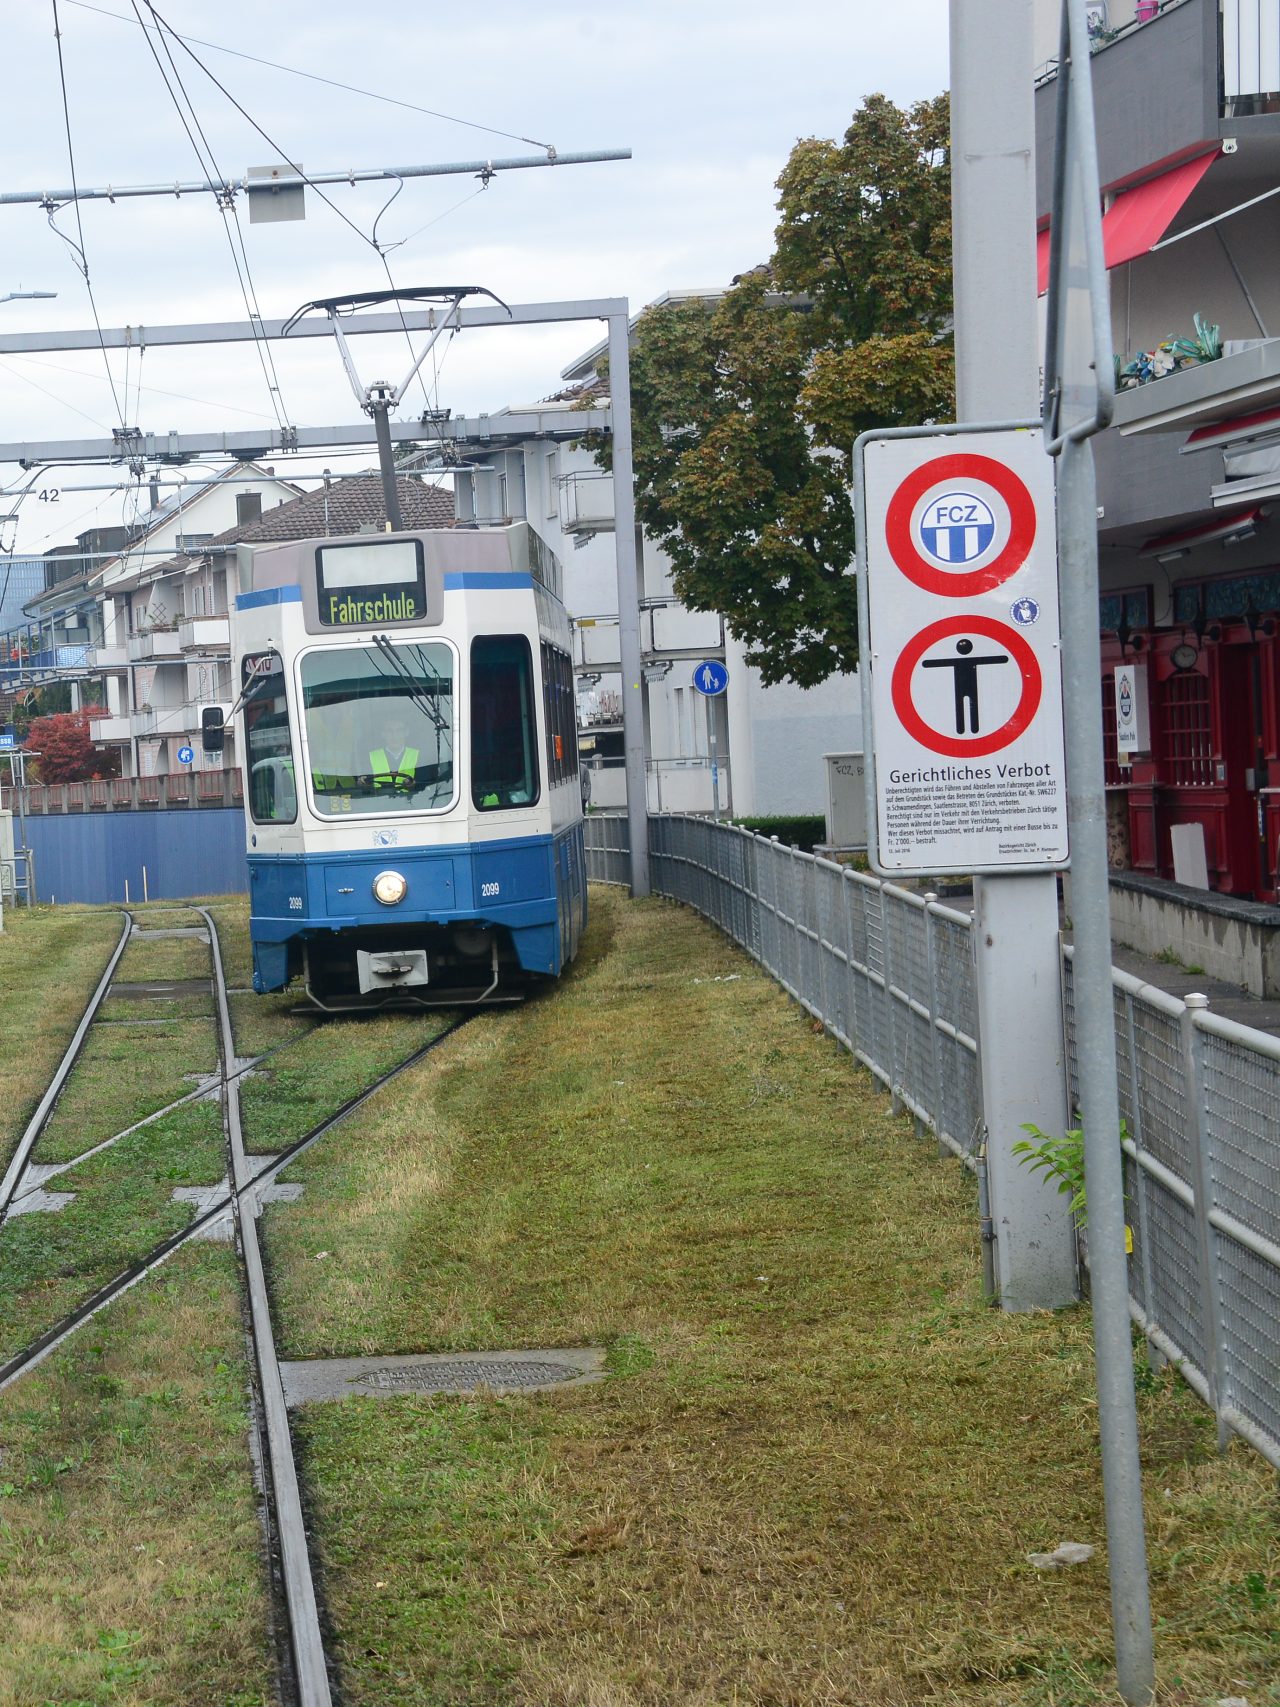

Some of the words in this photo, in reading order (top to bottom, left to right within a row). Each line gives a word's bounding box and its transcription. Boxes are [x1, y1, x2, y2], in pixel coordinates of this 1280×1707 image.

[38, 488, 60, 503] 42
[936, 505, 978, 524] FCZ
[330, 592, 416, 624] Fahrschule
[890, 765, 991, 784] Gerichtliches
[997, 763, 1051, 778] Verbot
[885, 786, 922, 795] Unberechtigten
[923, 785, 934, 793] wird
[935, 785, 944, 793] das
[944, 784, 961, 792] Führen
[973, 782, 995, 790] Abstellen
[1006, 781, 1035, 789] Fahrzeugen
[905, 794, 931, 802] Grundstück
[956, 792, 977, 800] Betreten
[986, 790, 1018, 798] Grundstückes
[1037, 788, 1057, 796] SW6227
[969, 800, 980, 808] 8051
[886, 812, 912, 821] Berechtigt
[940, 810, 960, 818] Verkehr
[981, 807, 1026, 816] Verkehrsbetrieben
[1042, 805, 1057, 814] tätige
[910, 820, 932, 828] während
[957, 818, 969, 826] ihrer
[970, 817, 1000, 825] Verrichtung.
[899, 829, 915, 837] dieses
[985, 825, 1003, 833] Antrag
[481, 882, 500, 897] 2099
[288, 897, 303, 909] 2099
